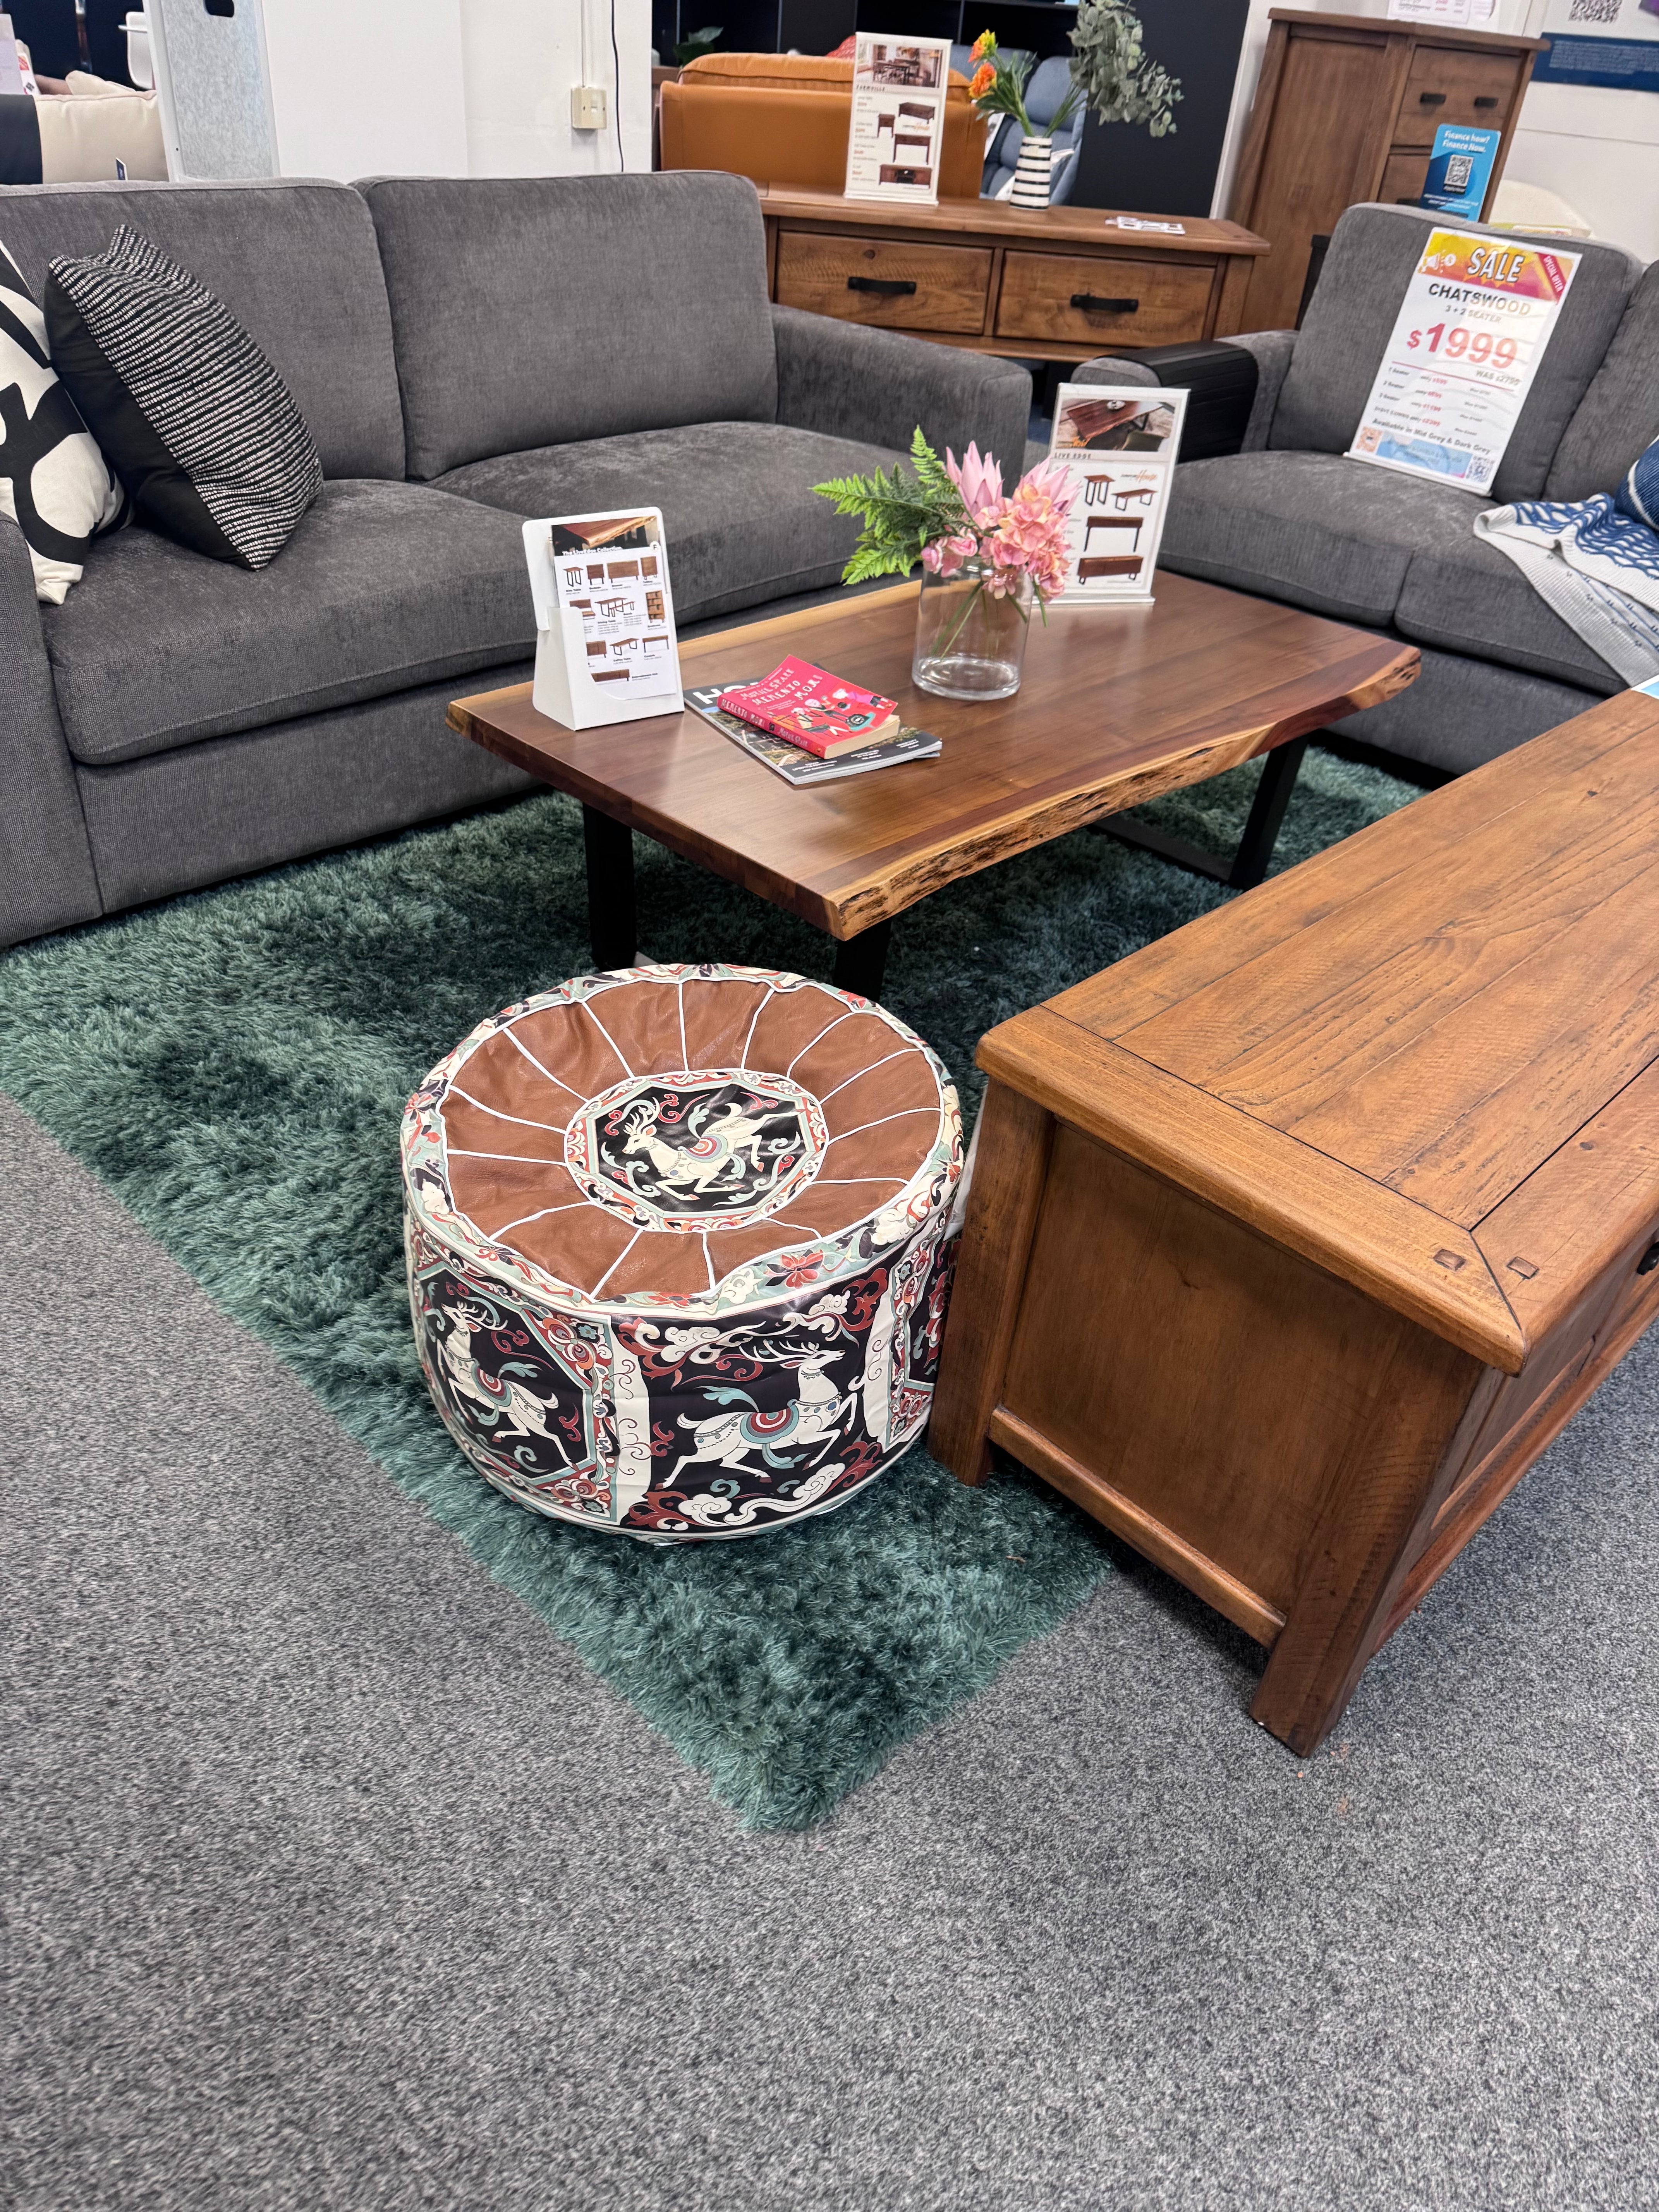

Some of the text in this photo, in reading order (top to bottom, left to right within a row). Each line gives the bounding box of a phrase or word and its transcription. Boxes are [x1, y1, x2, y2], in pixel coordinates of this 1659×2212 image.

[1442, 139, 1486, 152] Finance Now.
[1444, 130, 1490, 143] Finance how?
[1467, 246, 1526, 283] SALE
[1543, 255, 1564, 292] SPECIAL OFFER
[1428, 283, 1531, 316] CHATSWOOD
[1467, 310, 1502, 323] SEATER
[1407, 323, 1518, 369] $1999
[1476, 370, 1494, 380] WAS
[1372, 418, 1404, 430] Available
[1414, 428, 1427, 437] Mid
[1428, 433, 1445, 443] Grey
[1453, 439, 1472, 449] Dark
[1473, 444, 1491, 455] Grey
[752, 680, 801, 706] MEMENTO
[794, 675, 823, 701] MORI
[721, 699, 747, 718] MEMENTO
